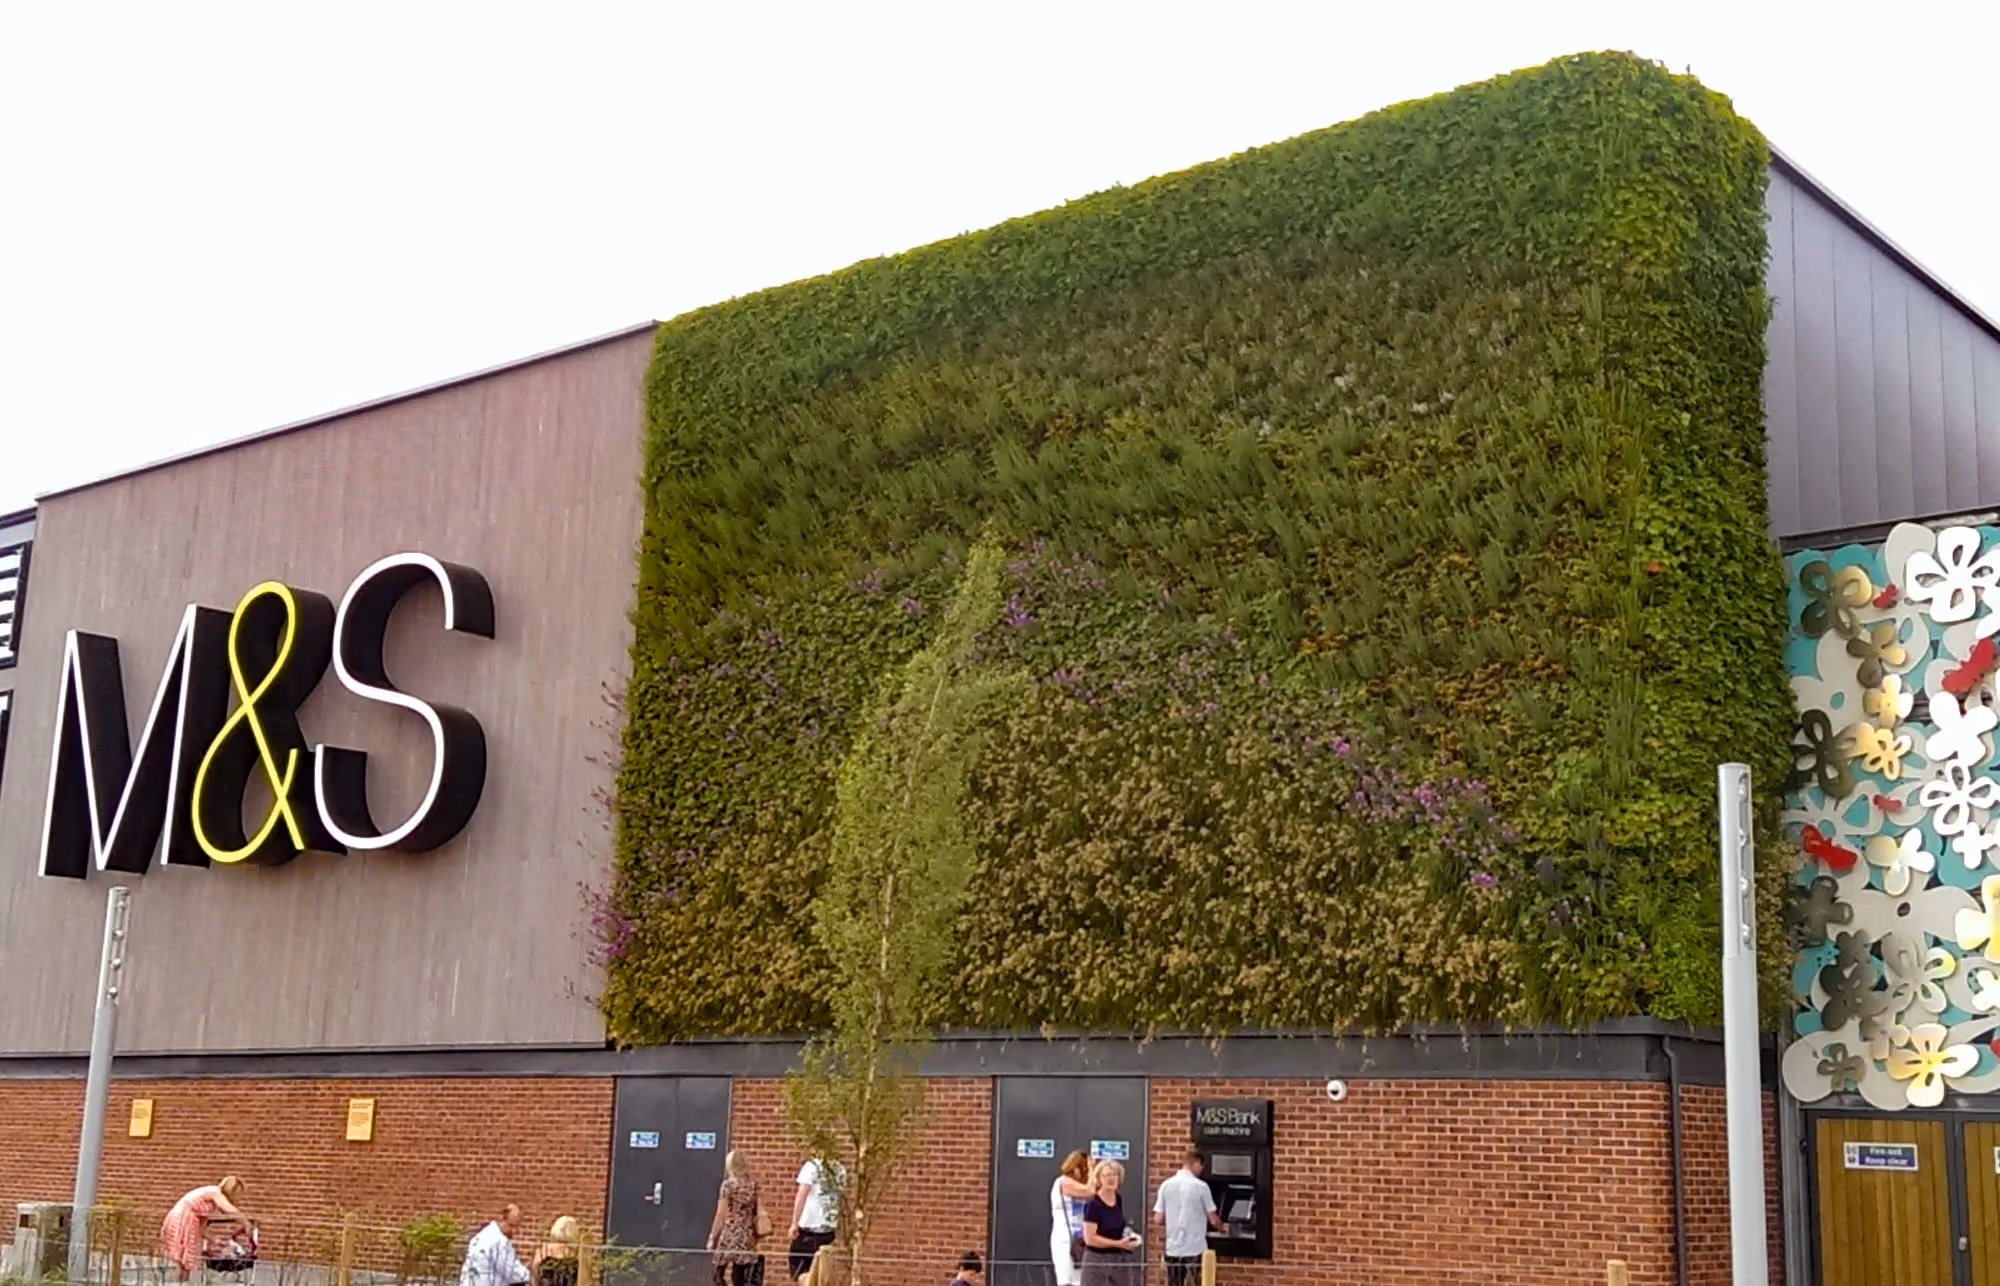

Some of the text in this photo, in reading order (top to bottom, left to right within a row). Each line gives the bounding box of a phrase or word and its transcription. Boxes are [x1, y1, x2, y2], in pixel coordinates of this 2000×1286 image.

[38, 552, 494, 879] M&S
[1196, 1106, 1261, 1125] M&S Bank
